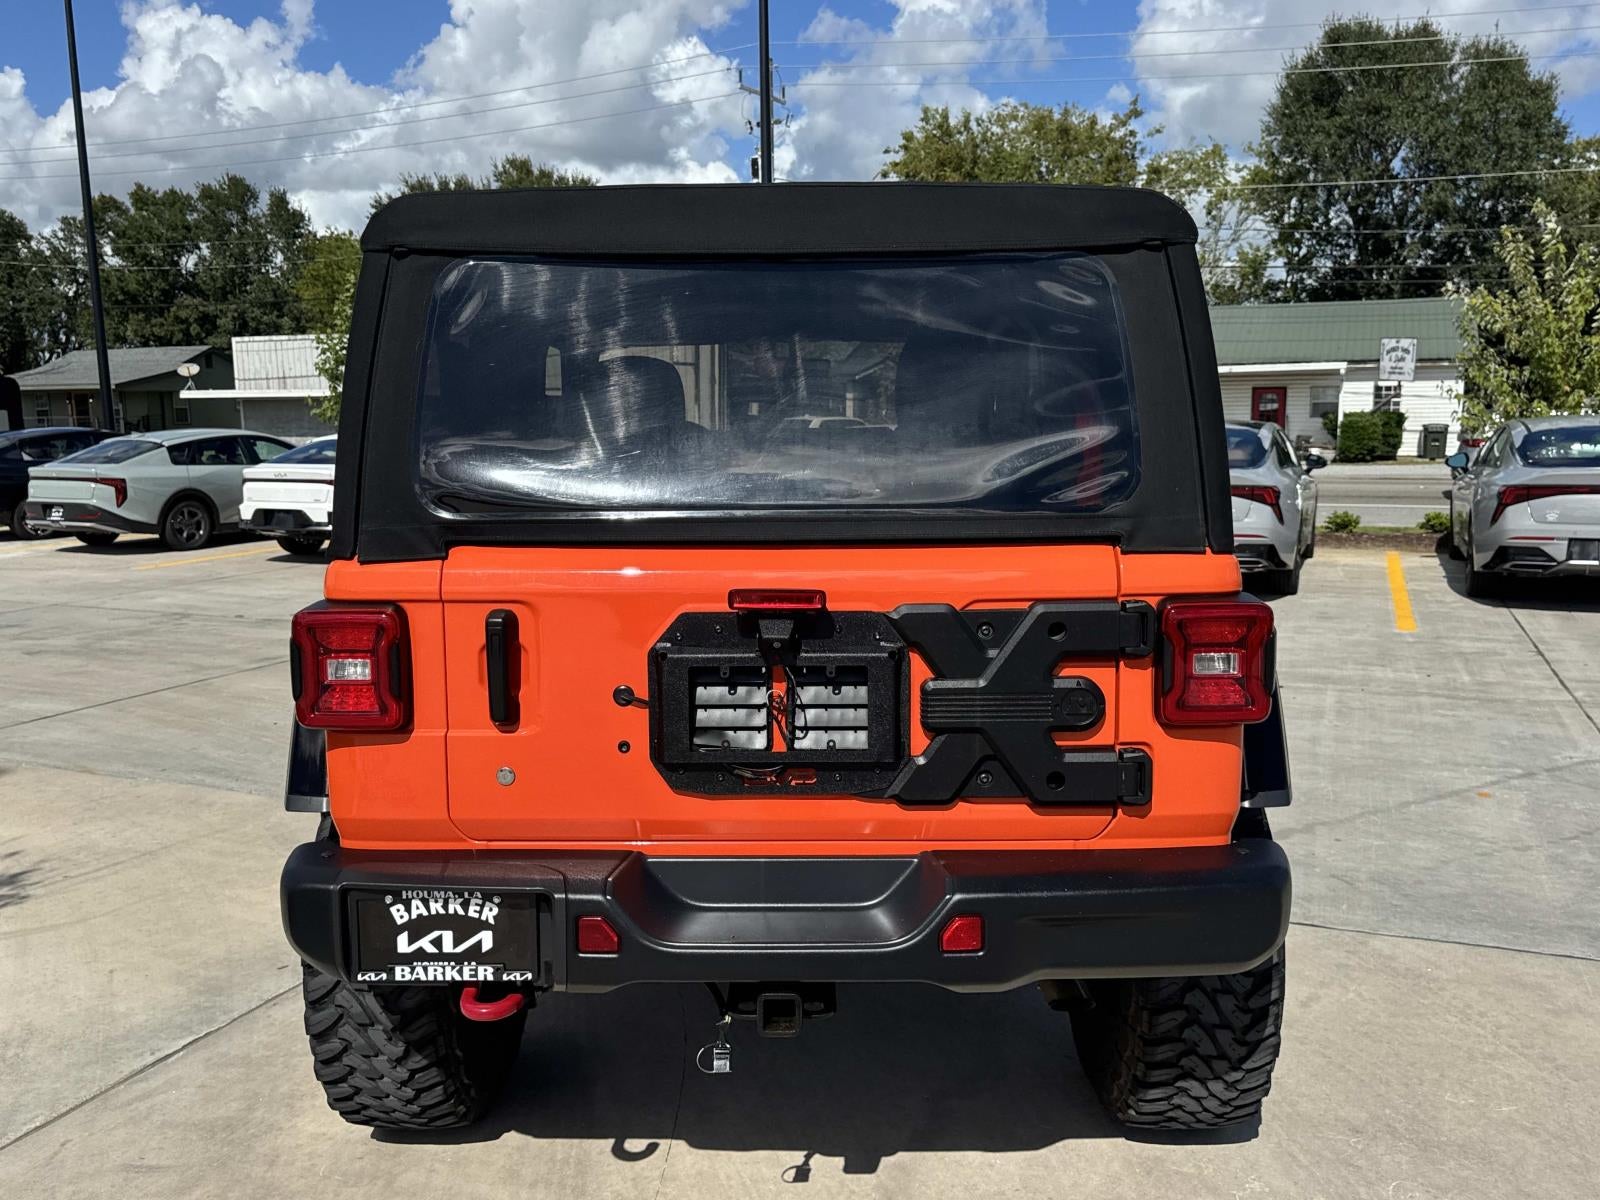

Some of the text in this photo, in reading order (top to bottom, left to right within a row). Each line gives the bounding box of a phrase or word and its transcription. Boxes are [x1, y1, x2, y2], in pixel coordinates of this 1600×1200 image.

[463, 891, 482, 899] LA
[389, 898, 499, 925] BARKER
[397, 930, 493, 953] KIA
[394, 966, 494, 981] BARKER
